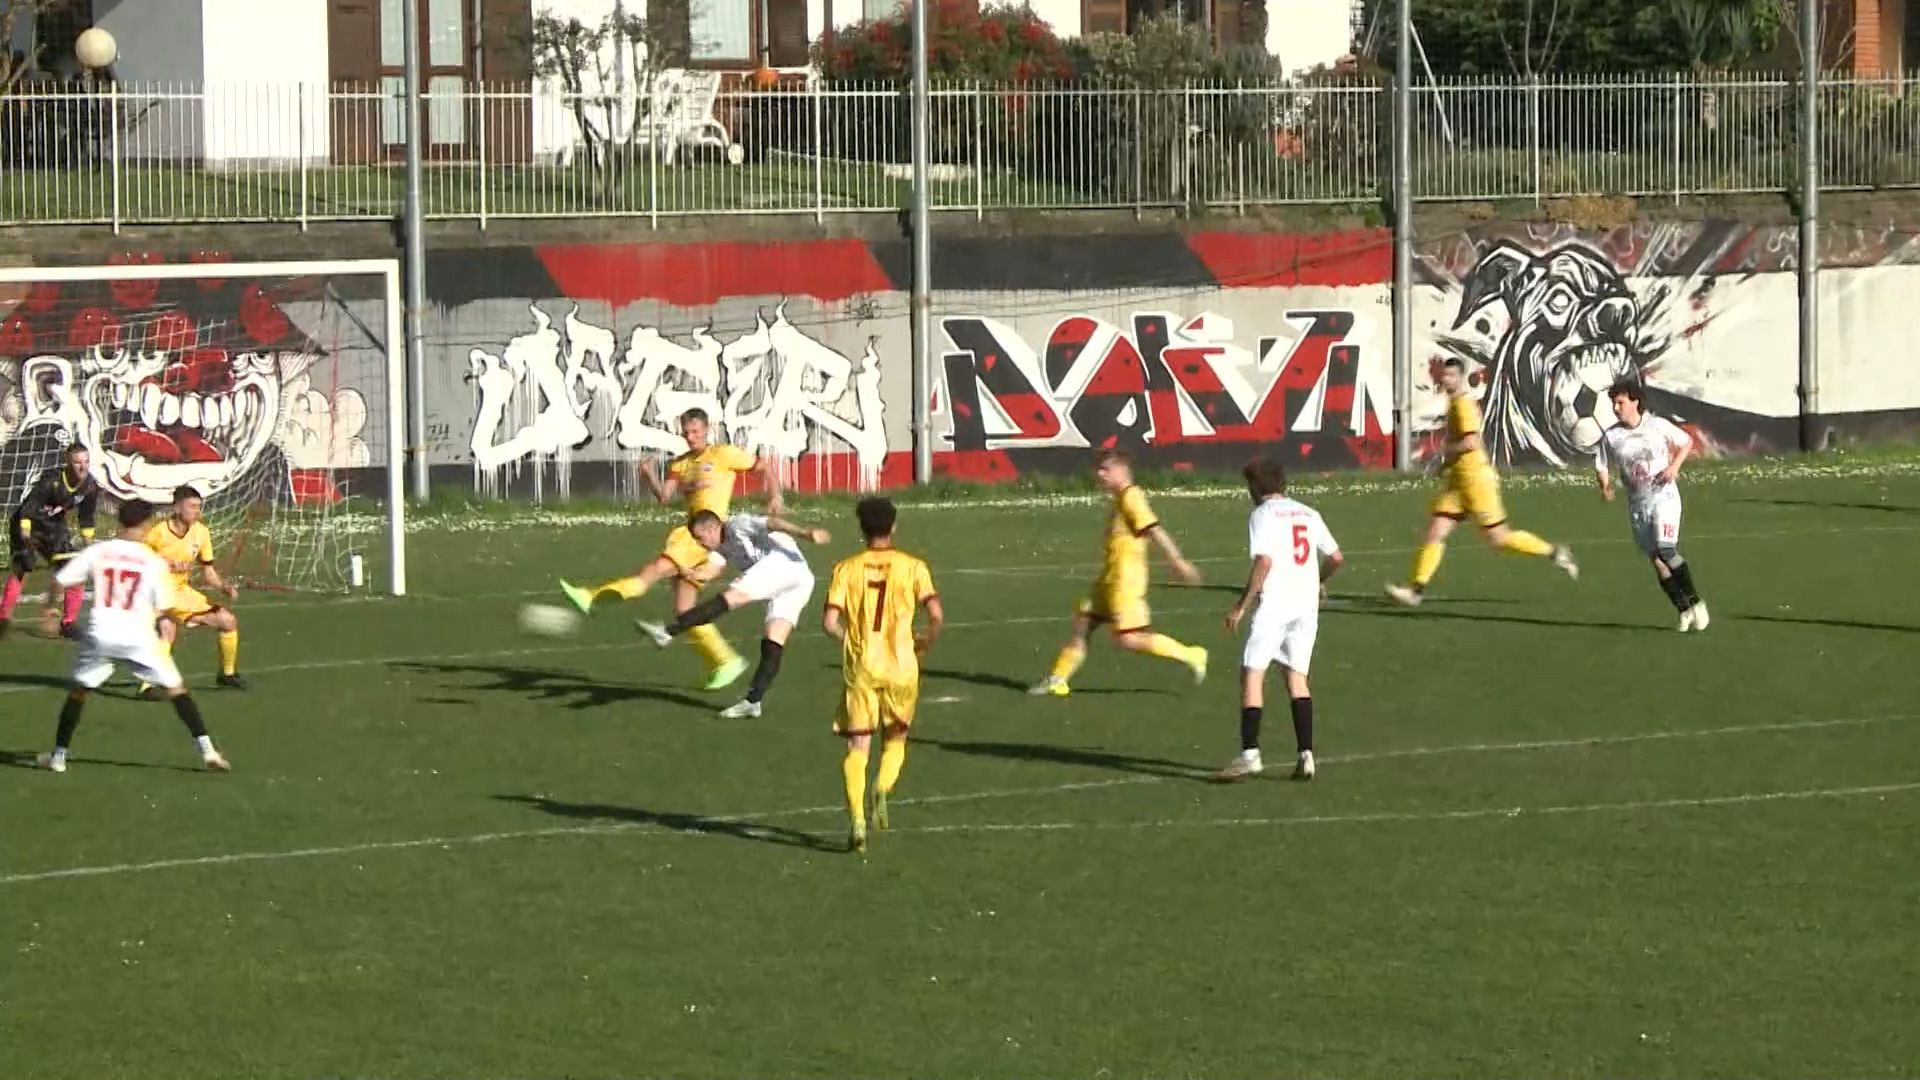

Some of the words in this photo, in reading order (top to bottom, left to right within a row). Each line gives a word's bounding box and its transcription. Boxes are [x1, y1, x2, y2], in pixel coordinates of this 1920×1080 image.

[1292, 525, 1310, 566] 5
[1662, 523, 1676, 538] 18
[103, 567, 142, 610] 17
[867, 580, 887, 632] 7
